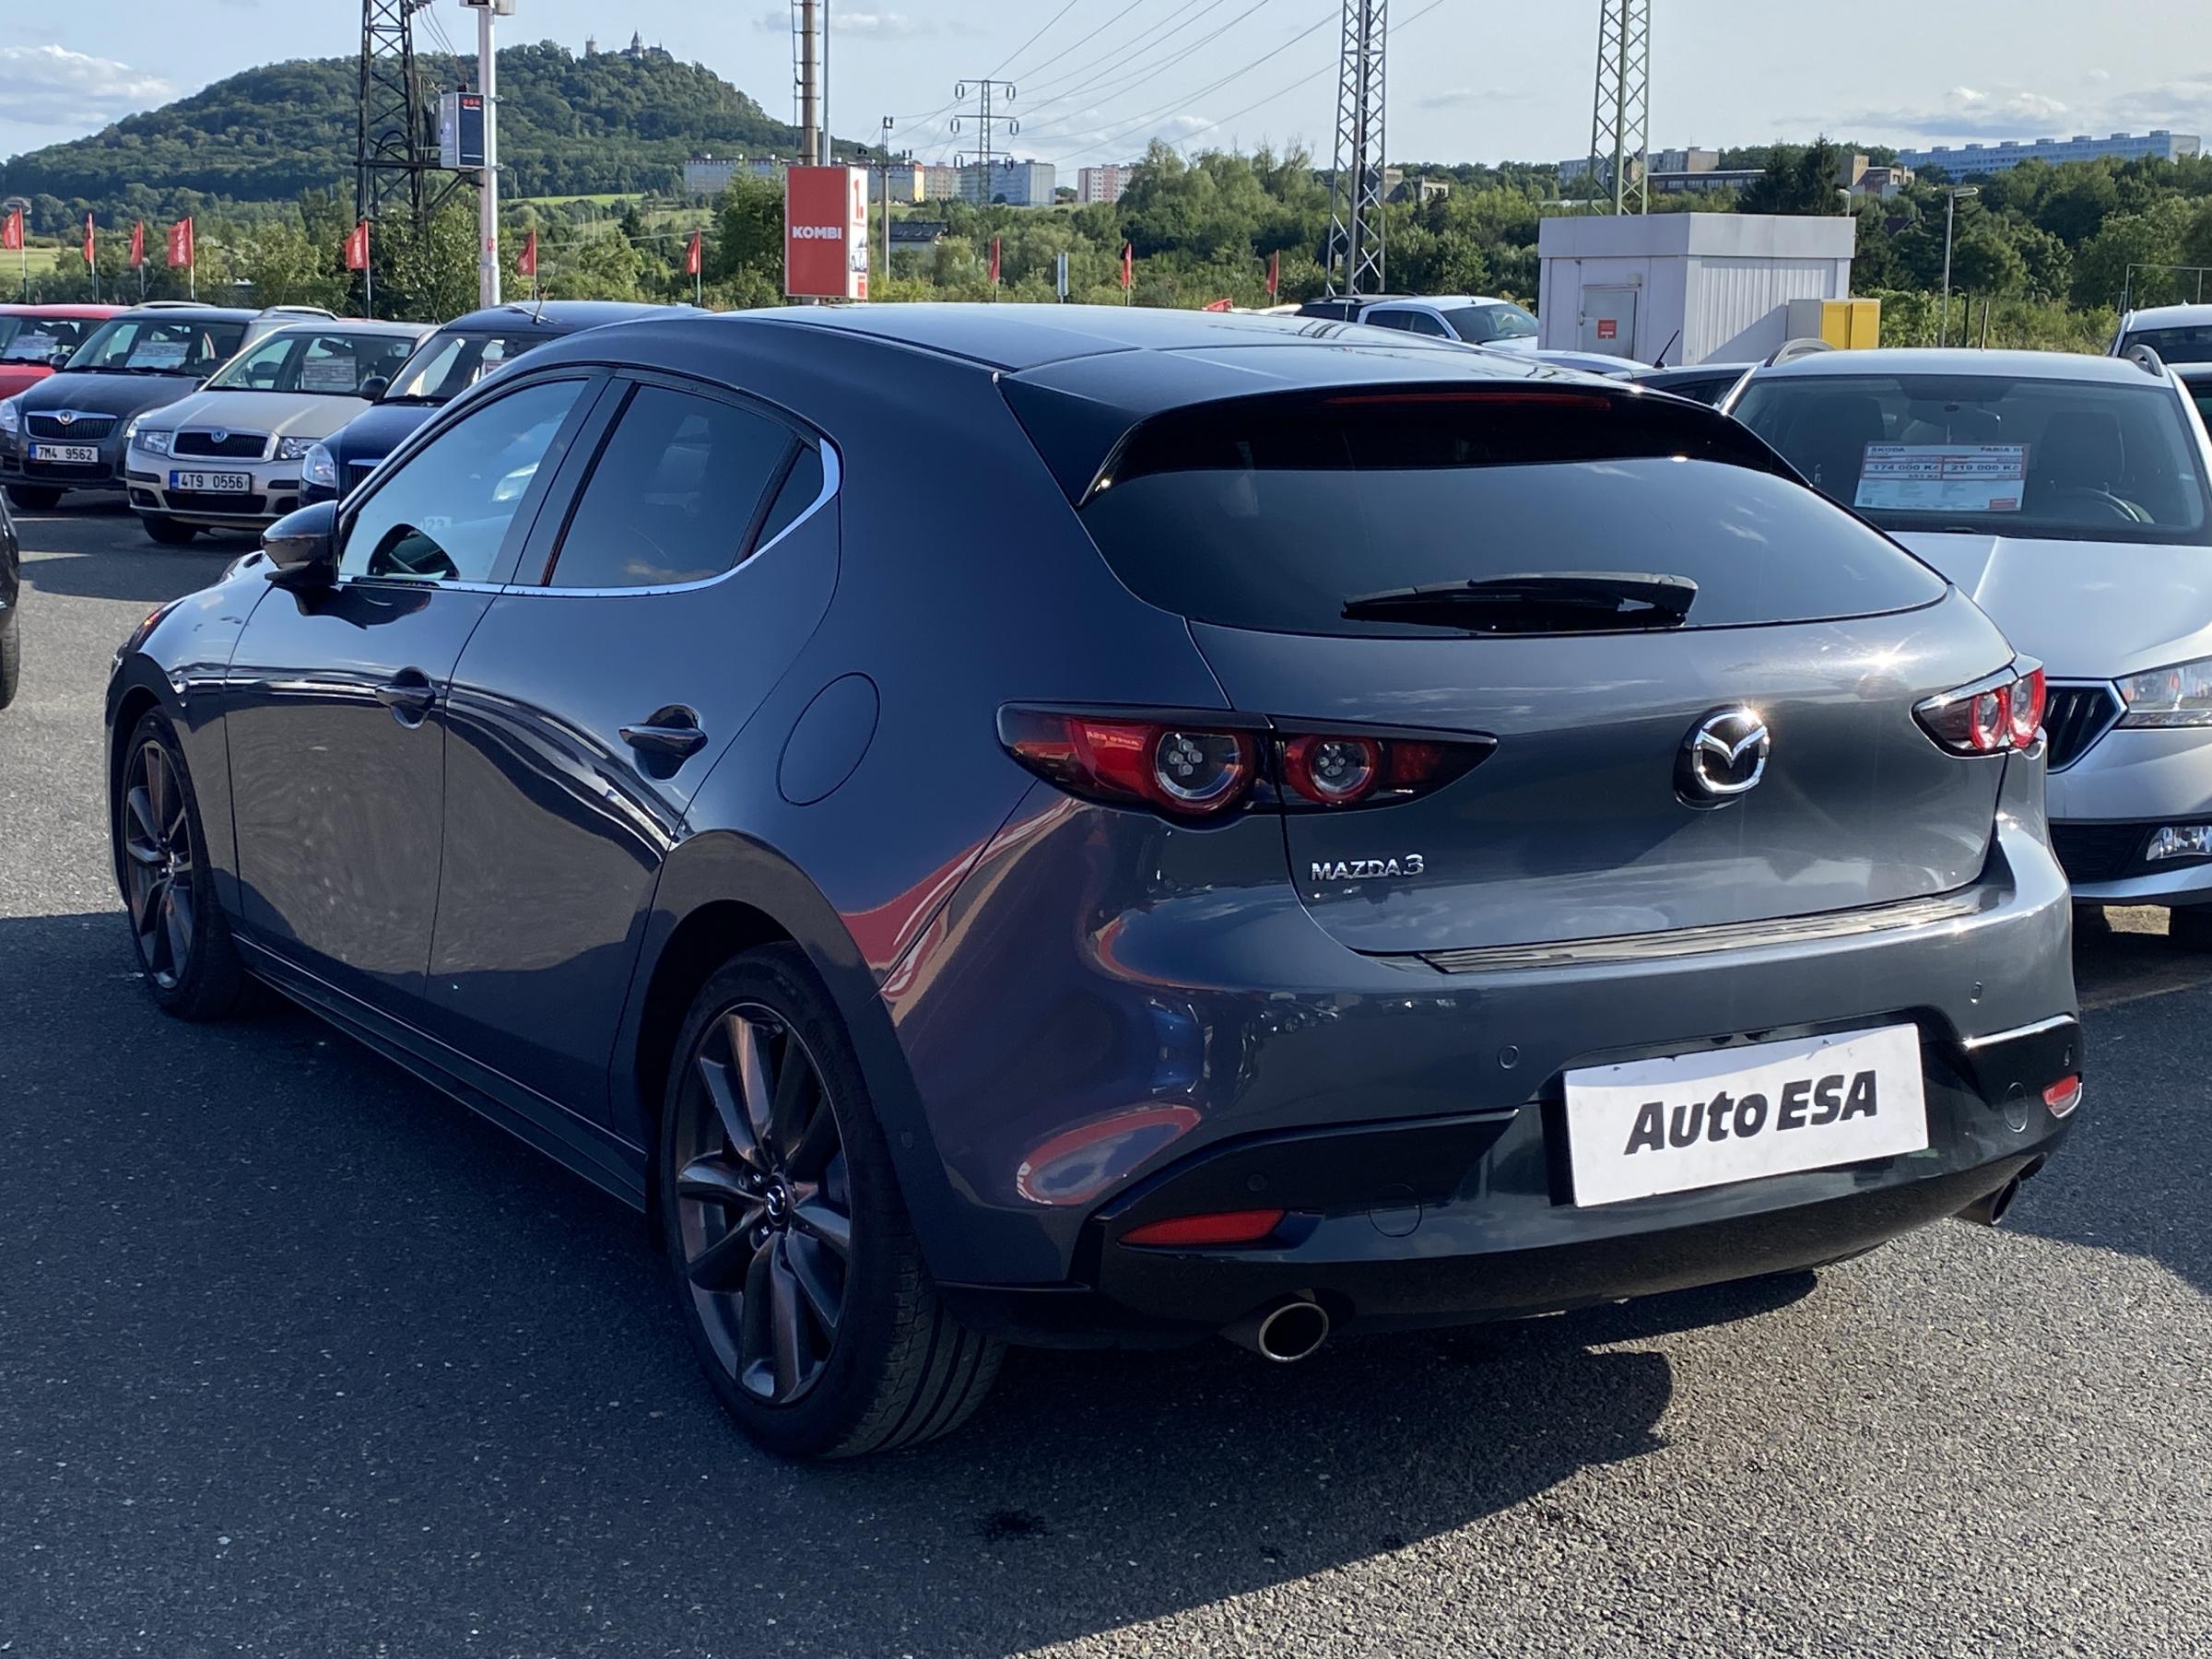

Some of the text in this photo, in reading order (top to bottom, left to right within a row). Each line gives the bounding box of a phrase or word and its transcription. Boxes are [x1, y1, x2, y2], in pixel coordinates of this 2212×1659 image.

[792, 226, 842, 240] KOMBI
[38, 446, 92, 461] 7M4 9562
[181, 475, 243, 489] 4T9 0556
[1623, 1069, 1877, 1156] Auto ESA
